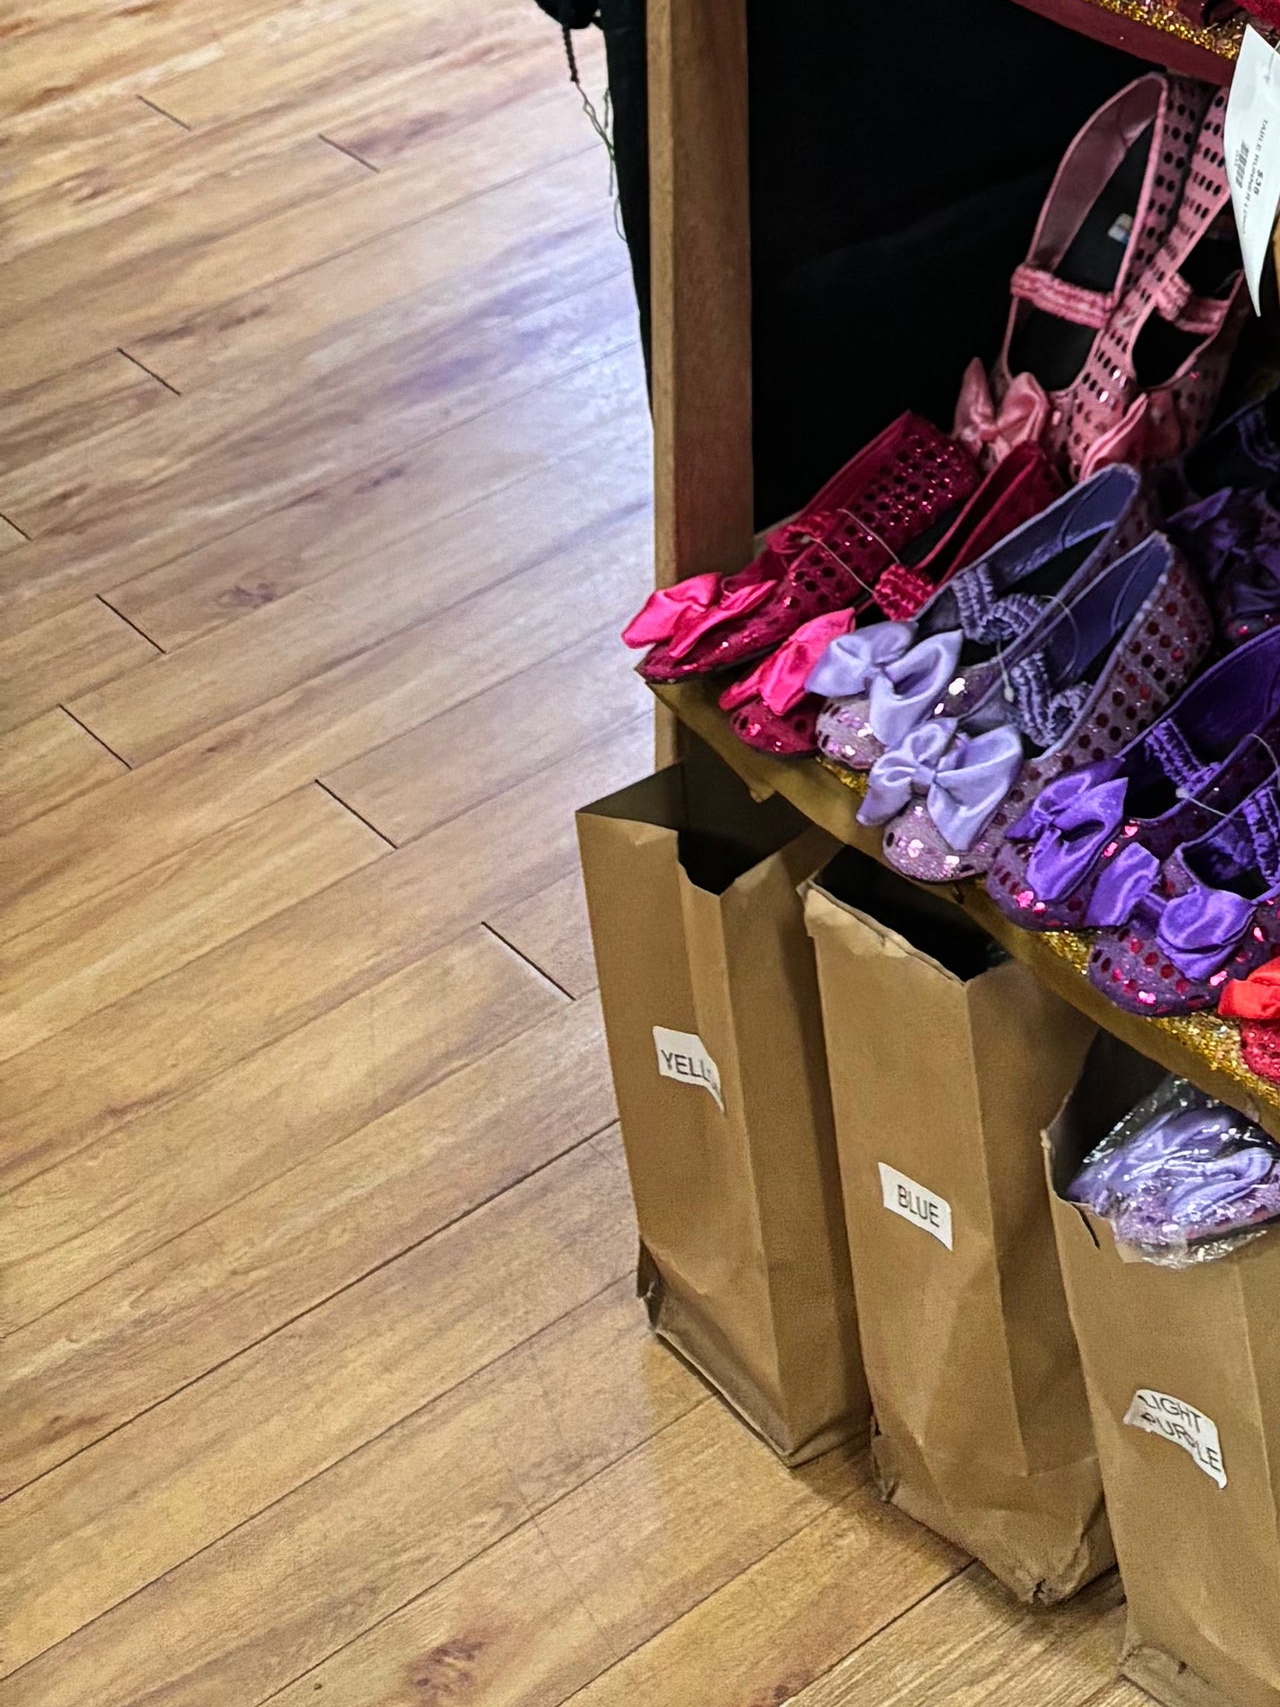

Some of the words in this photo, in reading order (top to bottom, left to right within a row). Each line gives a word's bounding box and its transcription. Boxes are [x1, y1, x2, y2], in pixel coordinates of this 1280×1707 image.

[897, 1183, 940, 1228] BLUE
[1137, 1394, 1201, 1433] LIGHT
[1140, 1412, 1222, 1473] PURPLE
